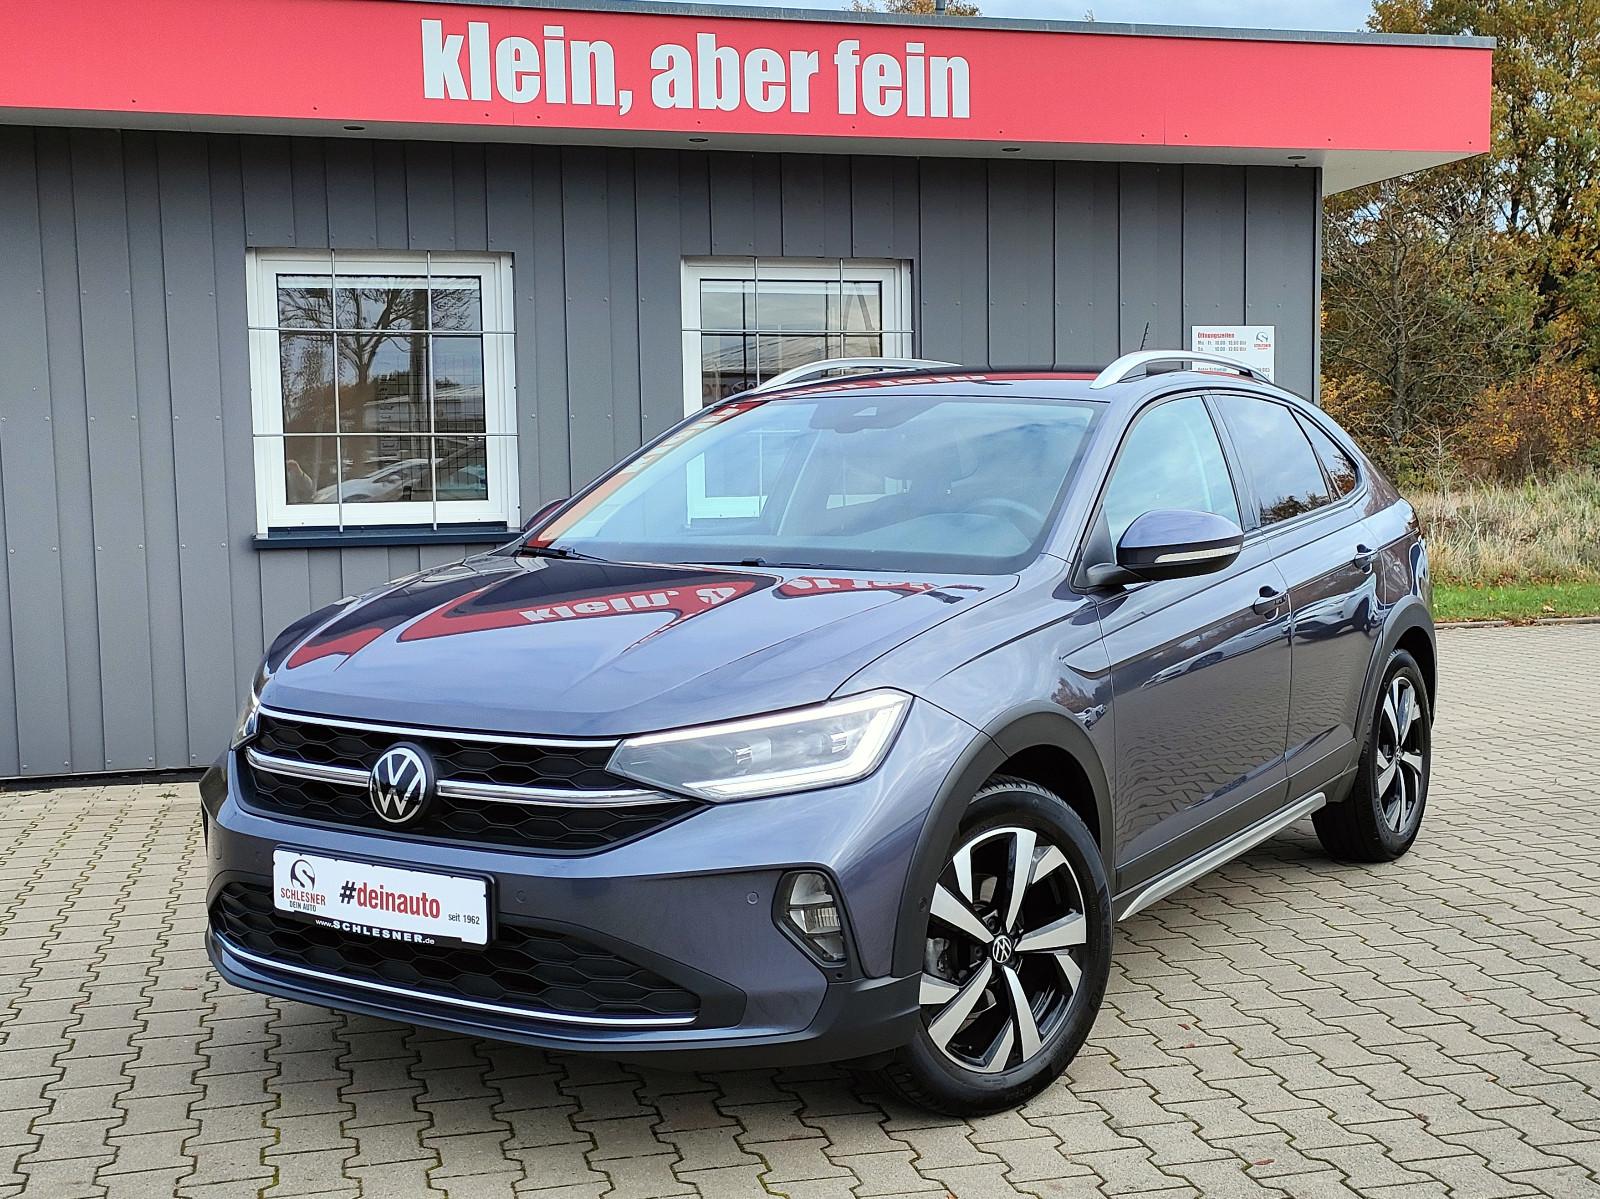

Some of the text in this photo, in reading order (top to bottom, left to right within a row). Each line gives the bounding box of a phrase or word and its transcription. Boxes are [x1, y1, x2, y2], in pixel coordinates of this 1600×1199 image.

[421, 19, 971, 119] klein, aber fein
[370, 747, 426, 823] VW
[280, 887, 326, 906] SCHLESNER
[289, 900, 317, 912] DEIN AUTO
[339, 880, 441, 919] #deinauto
[448, 912, 480, 926] seit 1962
